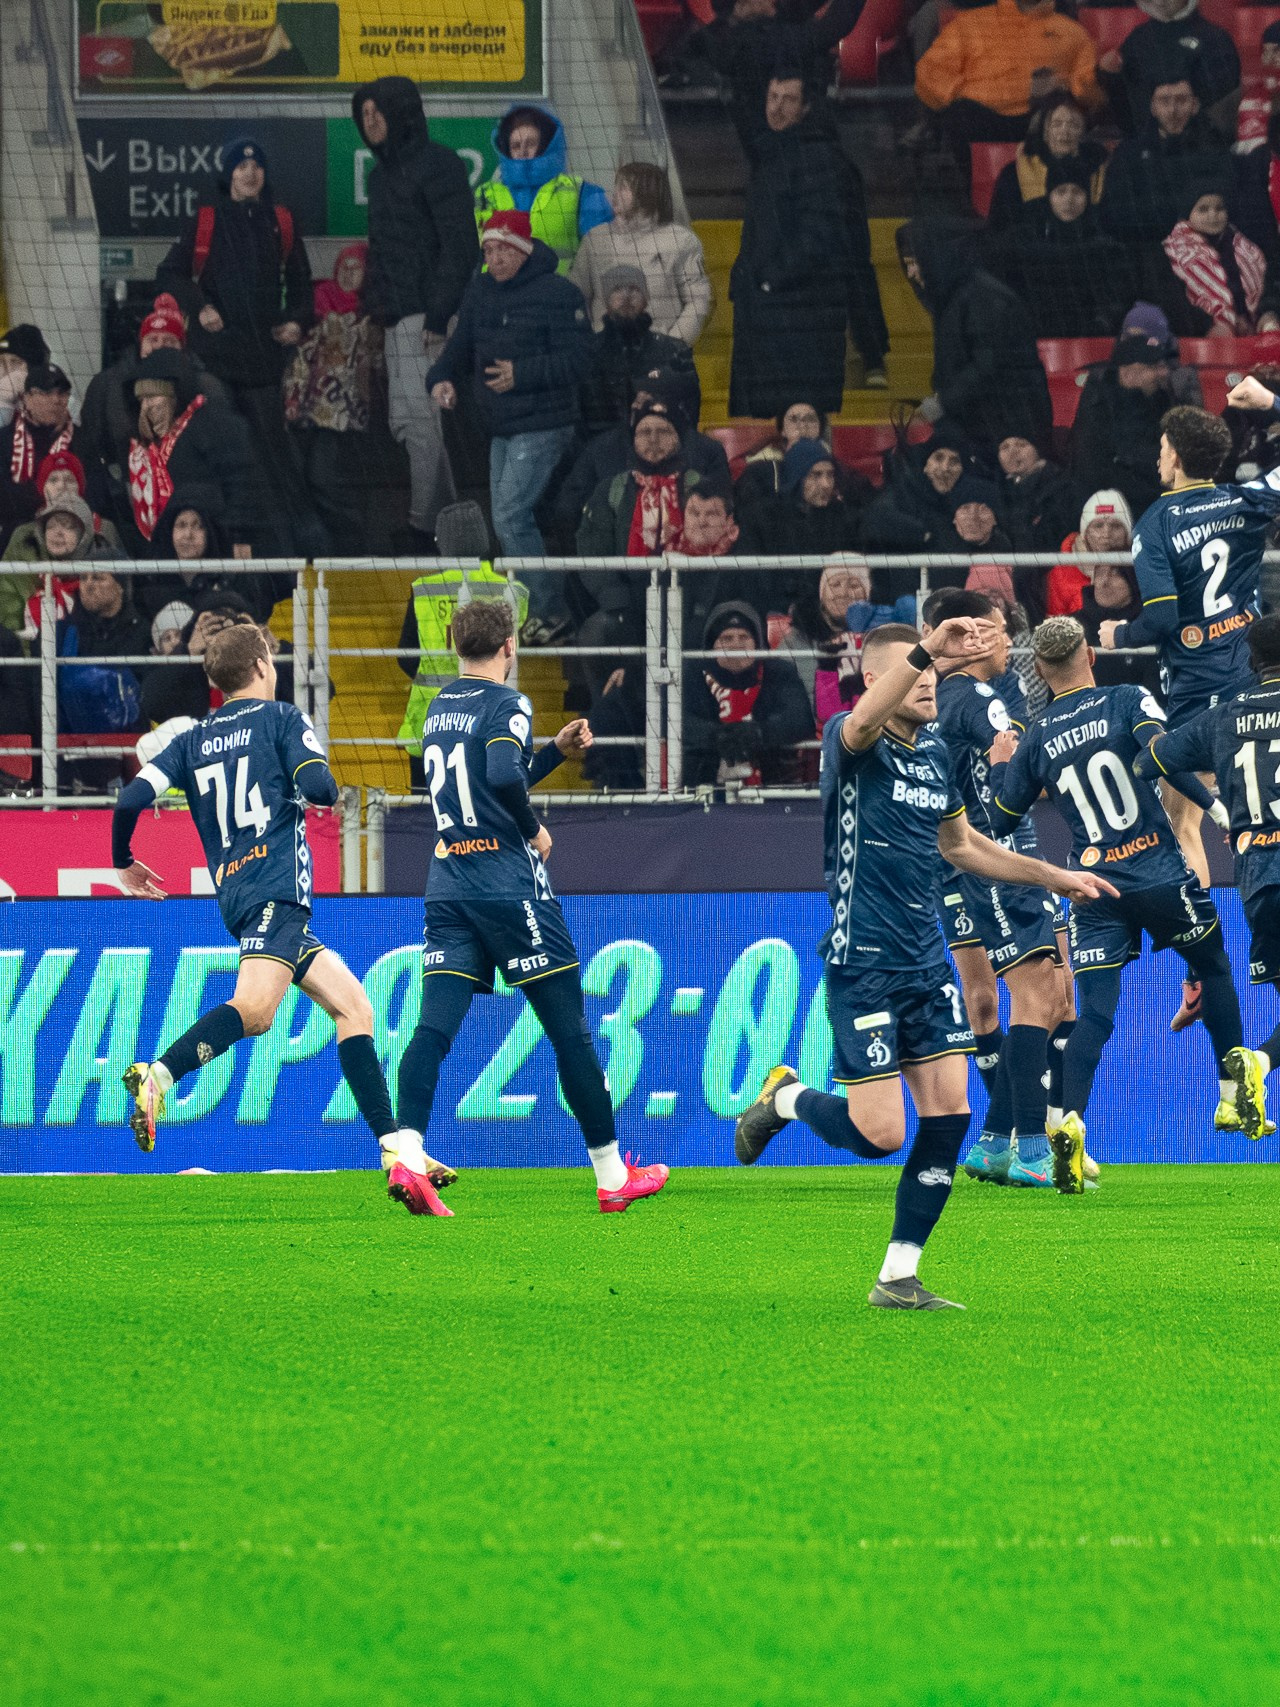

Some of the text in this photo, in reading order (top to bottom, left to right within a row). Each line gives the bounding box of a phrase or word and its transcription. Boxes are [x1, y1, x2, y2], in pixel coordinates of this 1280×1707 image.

[360, 22, 506, 39] закажи и забери
[359, 40, 506, 57] еду без очереди
[129, 183, 199, 218] Exit
[1200, 538, 1234, 618] 2
[201, 728, 252, 756] ФОМИН
[1043, 718, 1109, 760] БИТЕЛЛО
[423, 742, 478, 832] 21
[1055, 749, 1140, 844] 10
[194, 755, 272, 849] 74
[989, 885, 1012, 938] BetBoom
[240, 937, 265, 951] ВТБ
[994, 942, 1019, 962] ВТБ
[1079, 947, 1106, 964] ВТБ
[424, 950, 445, 967] ВТБ
[519, 952, 549, 972] ВТБ
[945, 1030, 975, 1043] BOSCO
